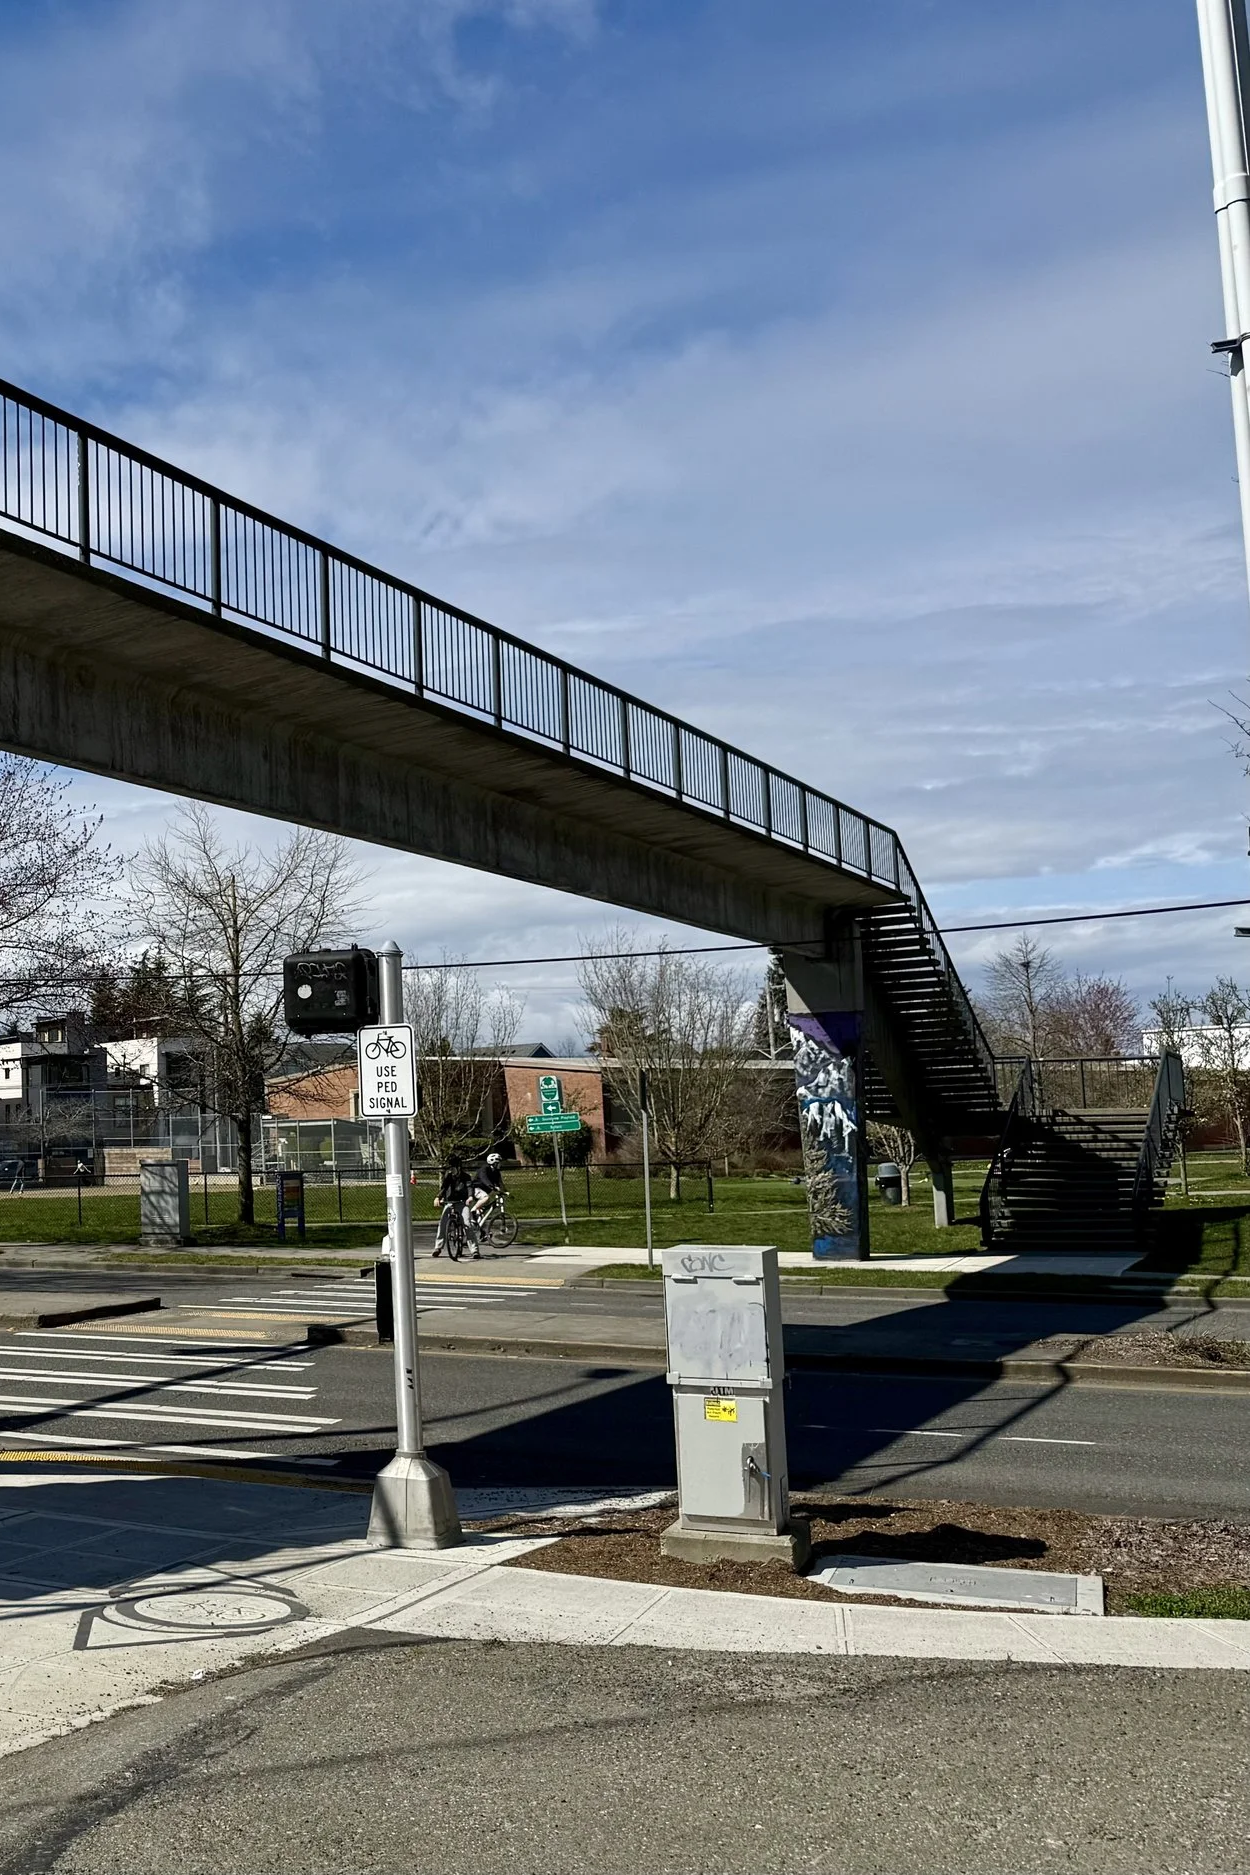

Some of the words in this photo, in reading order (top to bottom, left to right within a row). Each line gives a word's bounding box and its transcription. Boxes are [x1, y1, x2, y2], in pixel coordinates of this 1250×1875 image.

[376, 1065, 397, 1077] USE
[377, 1081, 397, 1093] PED
[369, 1096, 407, 1109] SIGNAL
